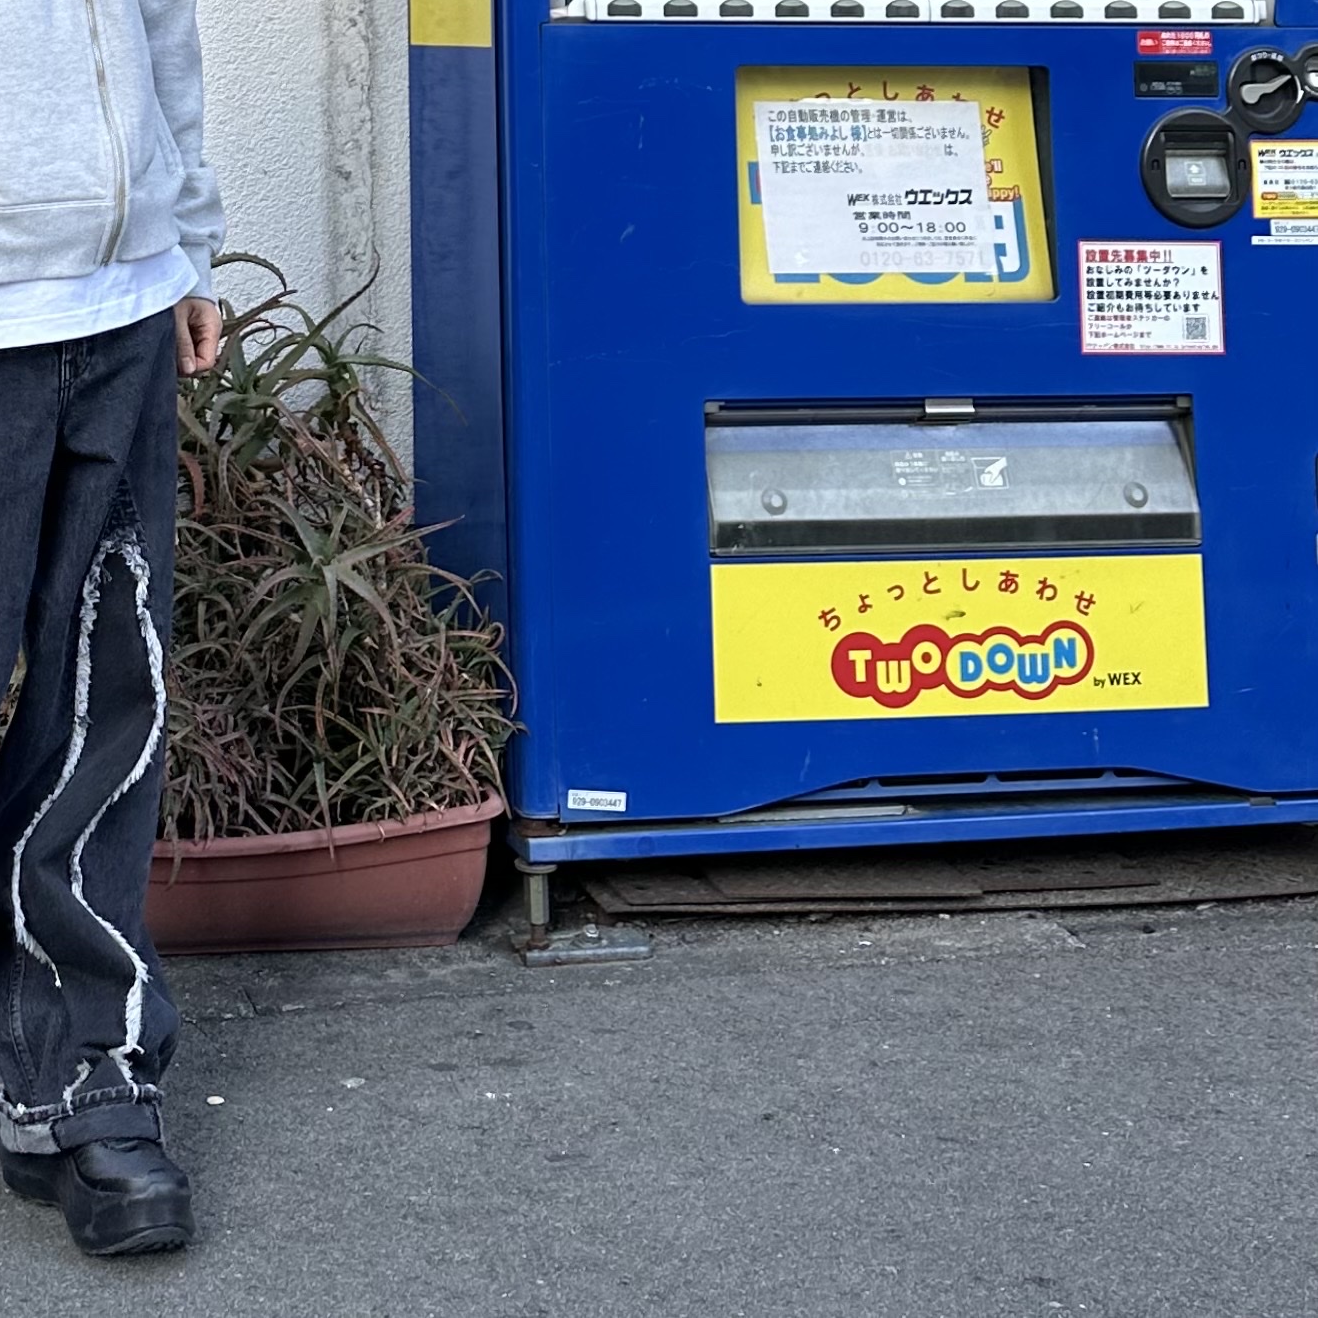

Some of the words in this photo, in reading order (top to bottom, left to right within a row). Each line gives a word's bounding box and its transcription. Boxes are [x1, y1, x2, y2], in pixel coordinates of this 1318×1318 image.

[847, 193, 870, 206] WEX
[904, 188, 973, 206] ウエックス
[852, 210, 912, 220] 営業時間
[817, 567, 1097, 632] ちょっとしあわせ
[848, 639, 943, 694] TWO
[959, 637, 1077, 685] DOWN
[1093, 676, 1106, 688] by
[1107, 672, 1142, 686] WEX
